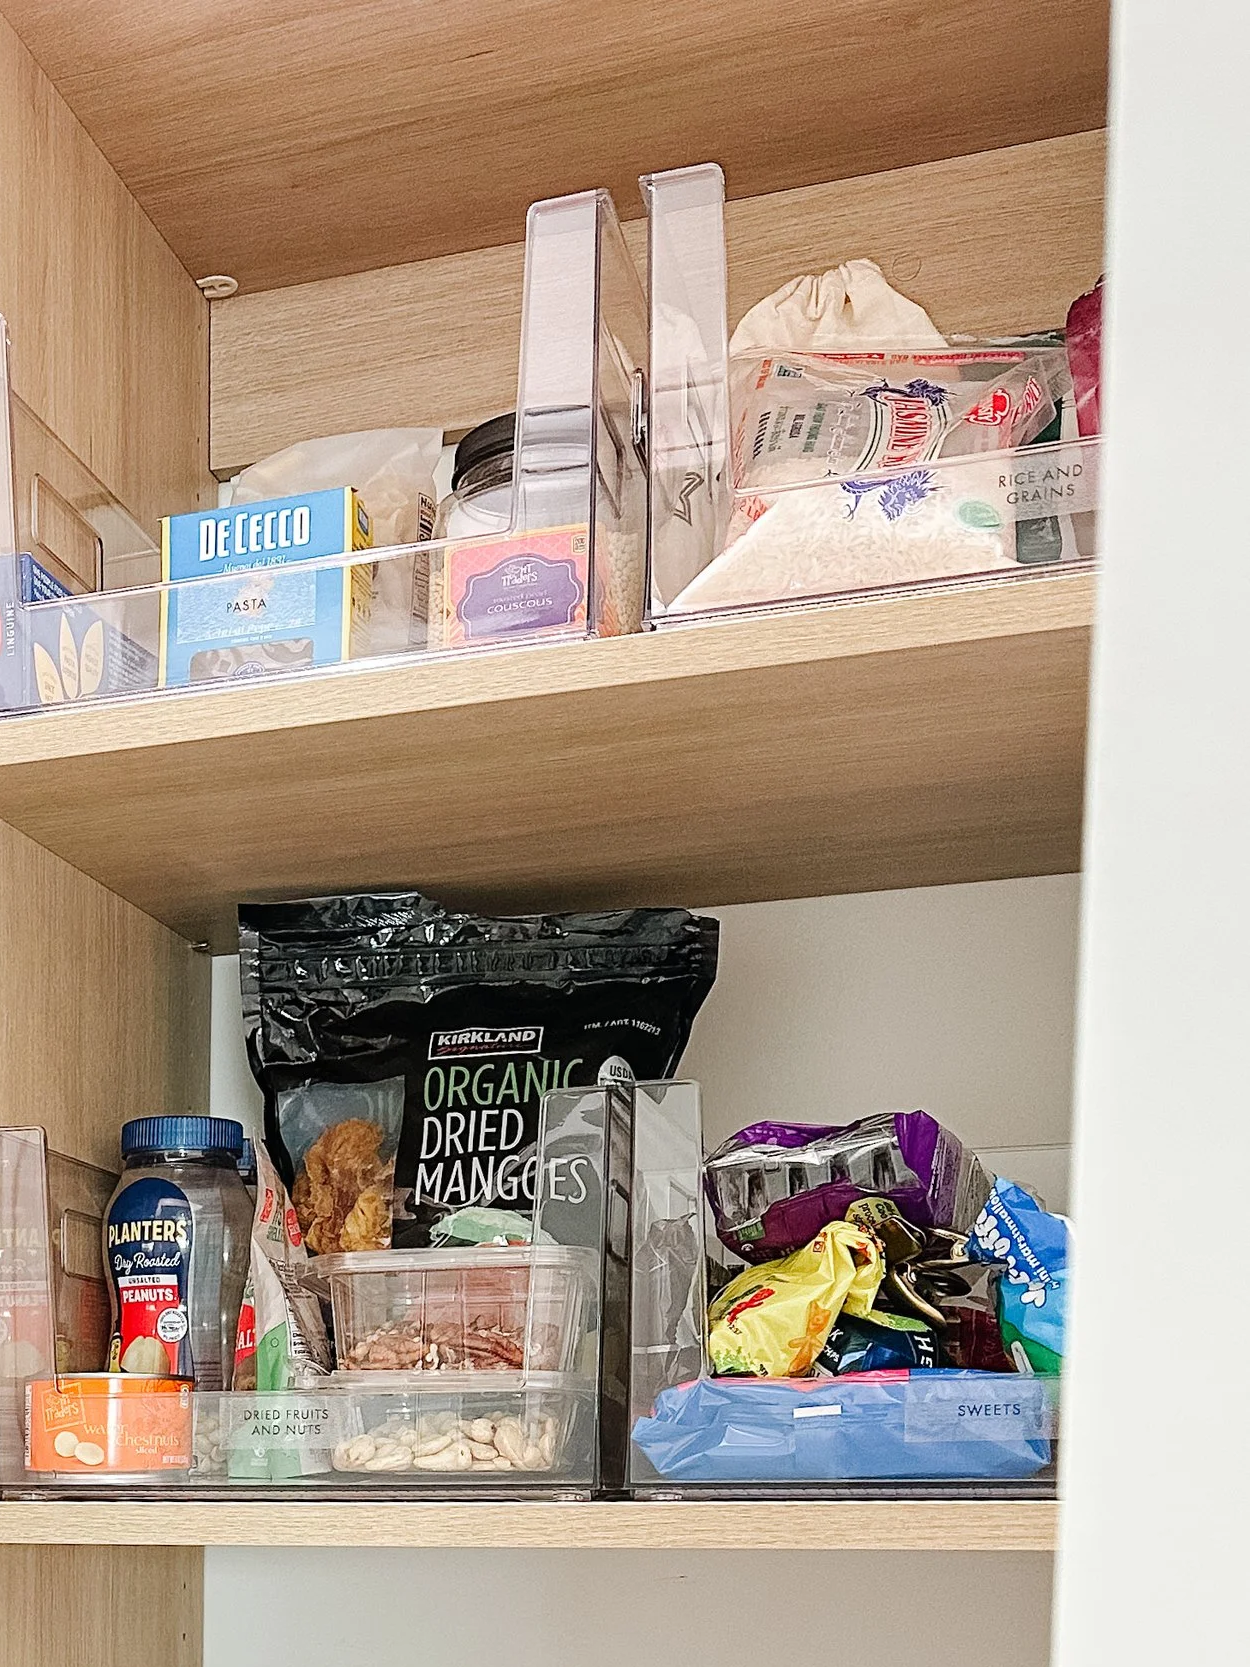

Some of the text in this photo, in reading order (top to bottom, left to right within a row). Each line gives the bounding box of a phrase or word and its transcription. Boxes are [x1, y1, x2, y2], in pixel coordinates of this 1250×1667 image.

[998, 464, 1083, 488] RICE AND
[1006, 484, 1075, 504] GRAINS
[199, 506, 312, 562] DE CECCO
[226, 598, 267, 613] PASTA
[6, 601, 15, 657] LINGUINE
[437, 1029, 537, 1046] KIRKLAND
[423, 1058, 584, 1111] ORGANIC
[419, 1109, 524, 1160] DRIED
[109, 1219, 188, 1249] PLANTERS
[114, 1251, 181, 1275] Dry Roasted
[243, 1408, 329, 1422] DRIED FRUITS
[957, 1403, 1021, 1417] SWEETS
[83, 1423, 128, 1435] waer
[251, 1423, 322, 1436] AND NUTS
